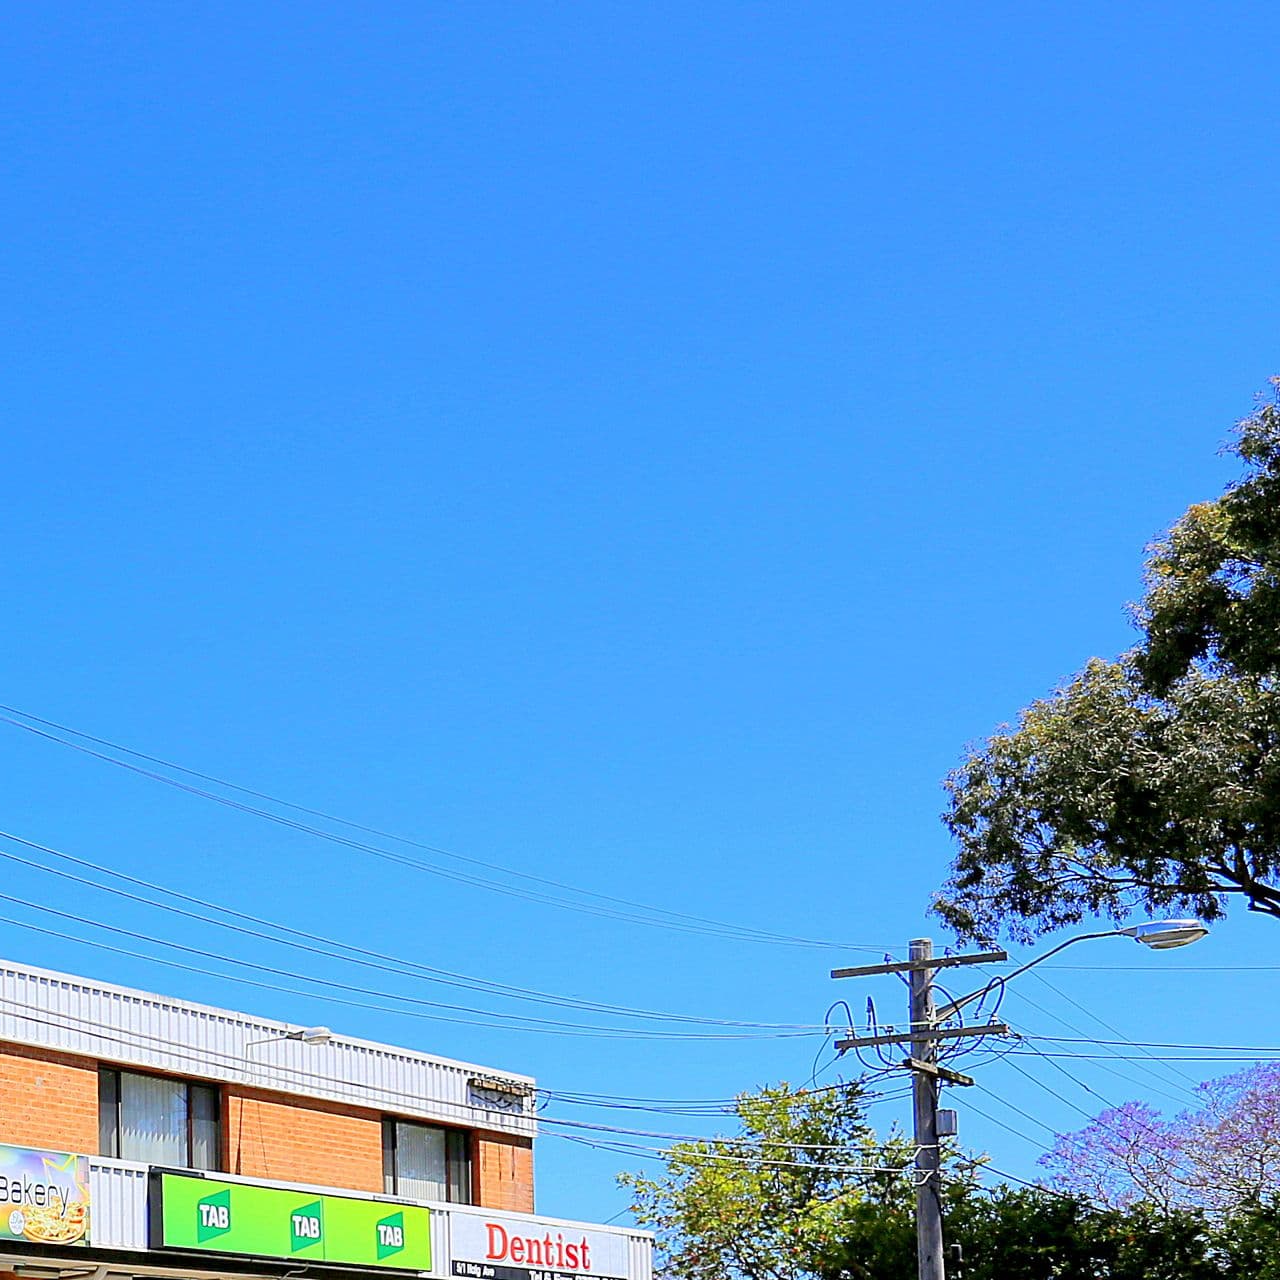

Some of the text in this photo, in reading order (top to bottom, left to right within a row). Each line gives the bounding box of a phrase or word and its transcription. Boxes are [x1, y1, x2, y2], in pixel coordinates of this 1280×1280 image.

[199, 1203, 231, 1230] TAB
[292, 1213, 321, 1239] TAB
[377, 1223, 404, 1247] TAB
[485, 1222, 591, 1270] Dentist
[482, 1265, 495, 1277] Ave
